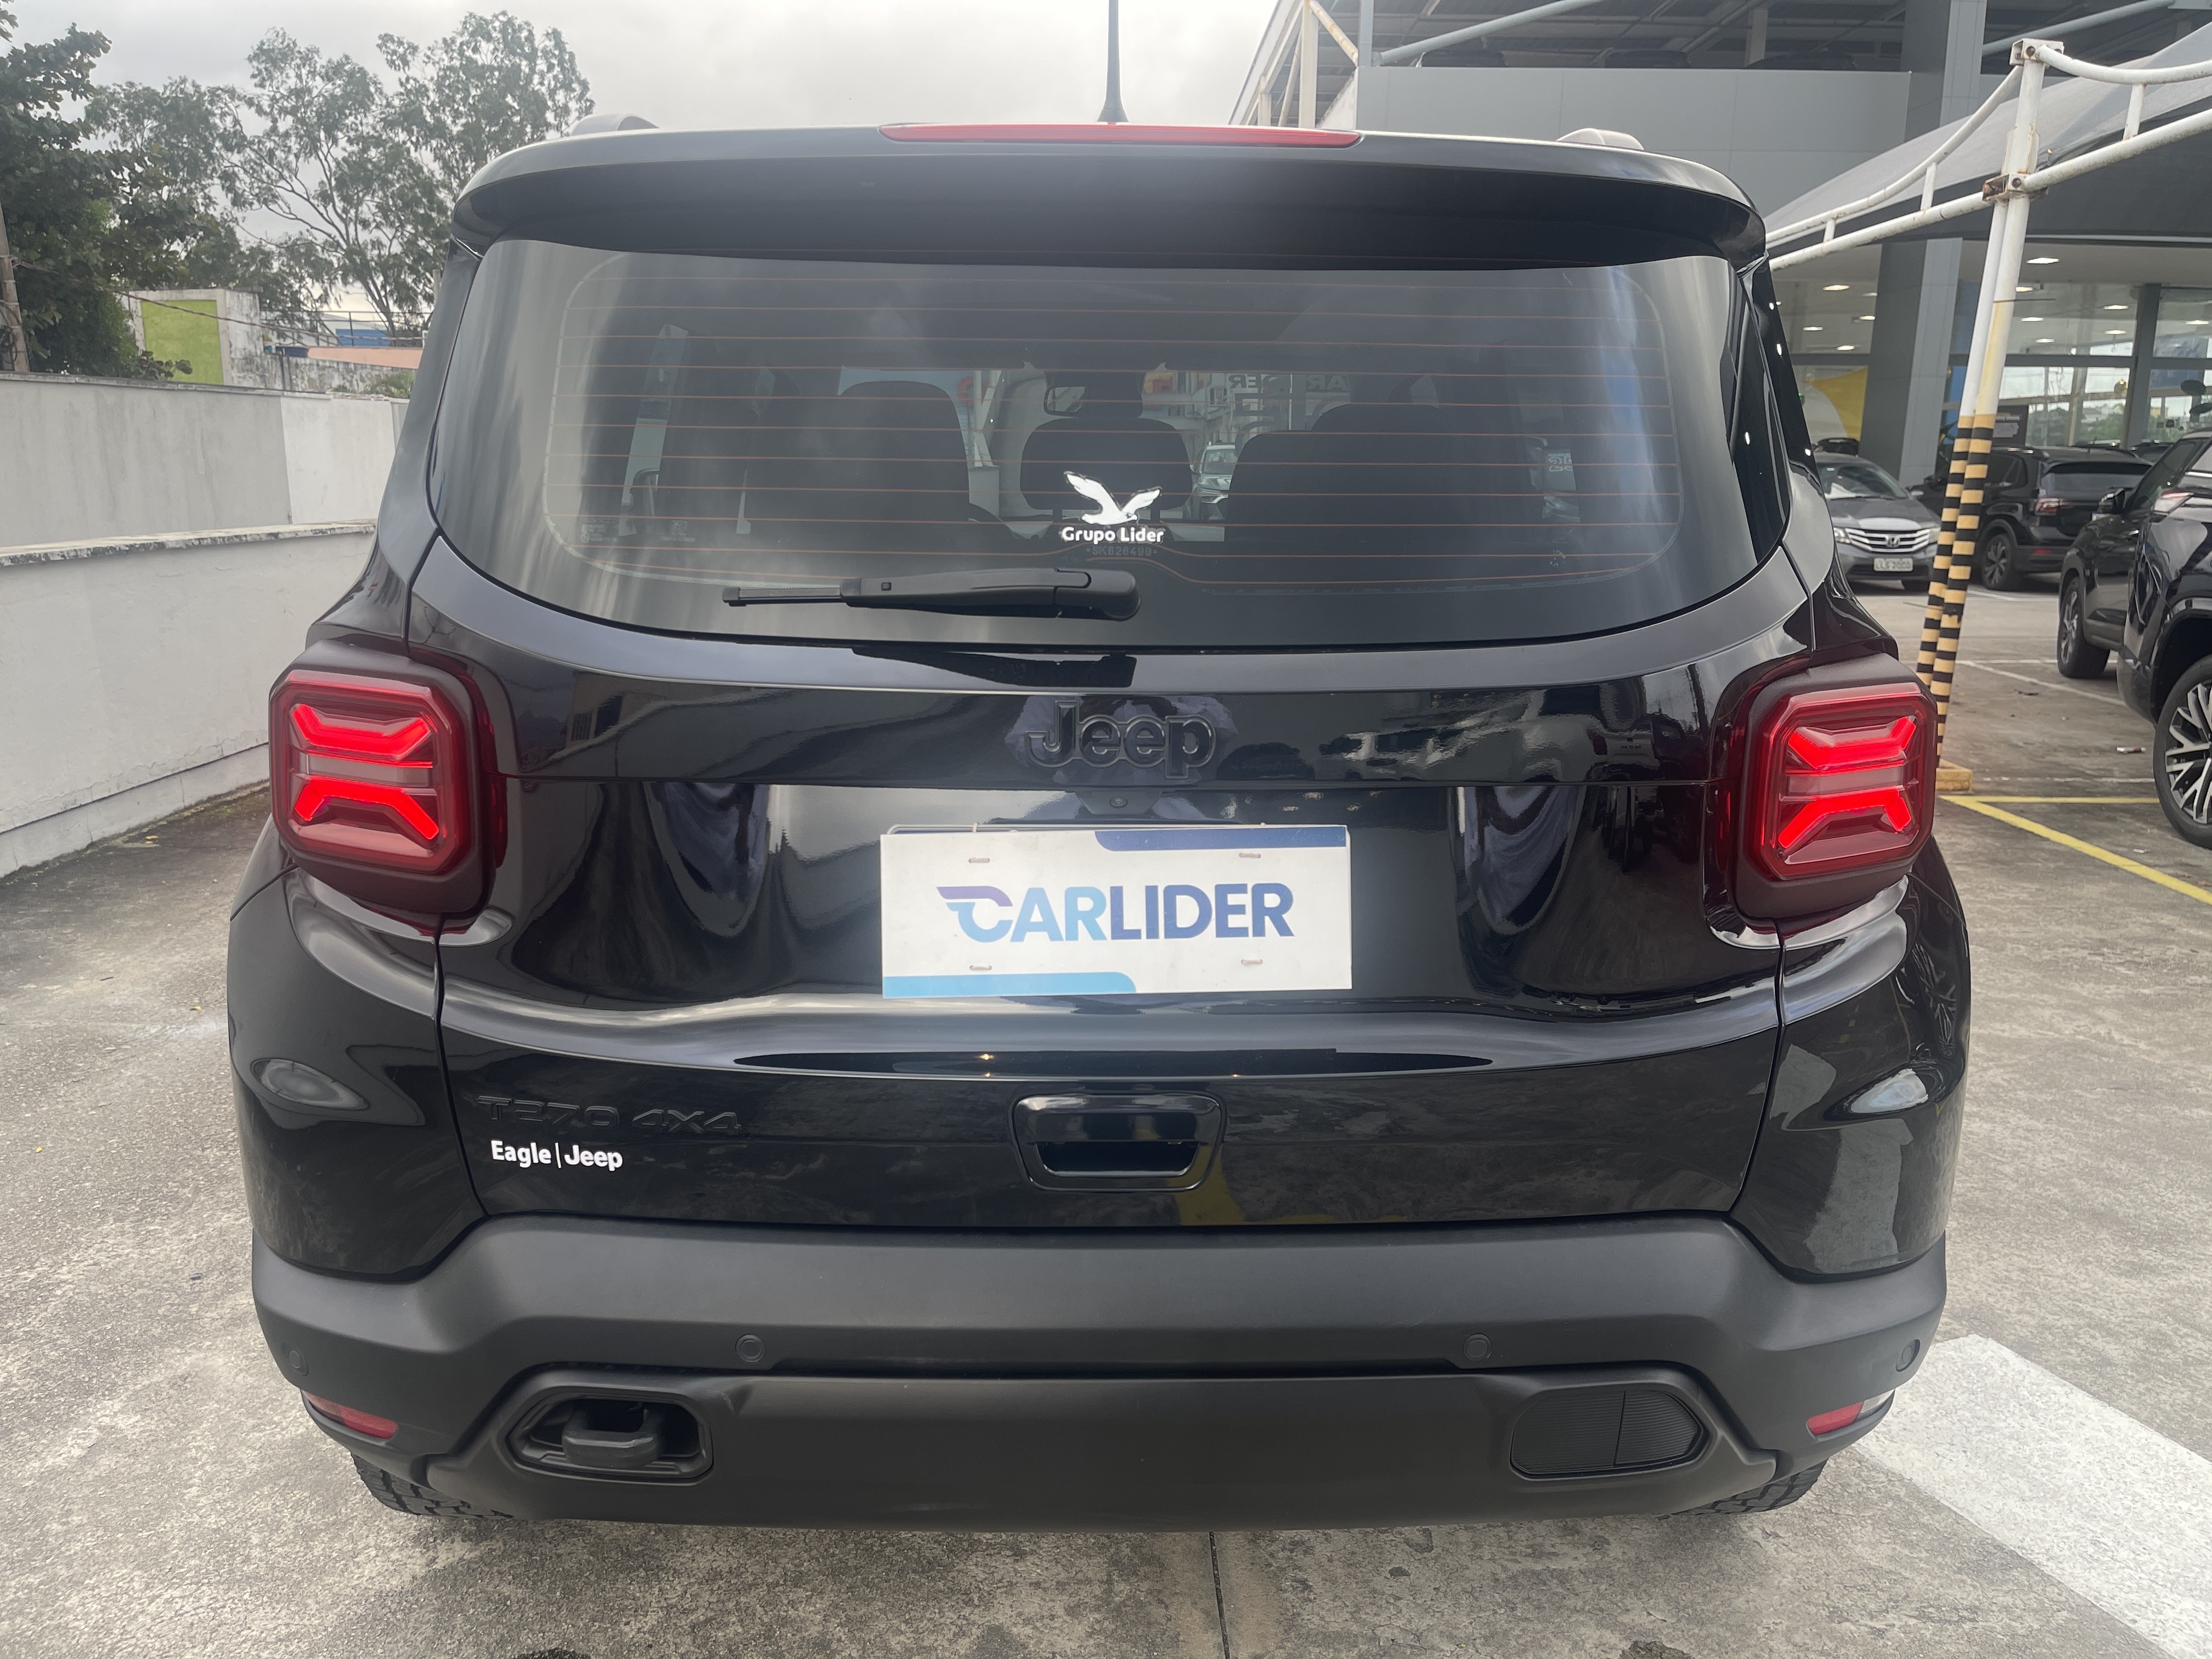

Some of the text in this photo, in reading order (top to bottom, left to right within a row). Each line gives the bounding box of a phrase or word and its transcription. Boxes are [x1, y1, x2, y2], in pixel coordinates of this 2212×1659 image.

[1062, 527, 1164, 544] Grupo Lider
[1025, 701, 1216, 780] Jeep
[936, 883, 1295, 943] CARLIDER
[478, 1096, 620, 1127] T270
[491, 1140, 552, 1168] Eagle
[564, 1144, 623, 1171] Jeep
